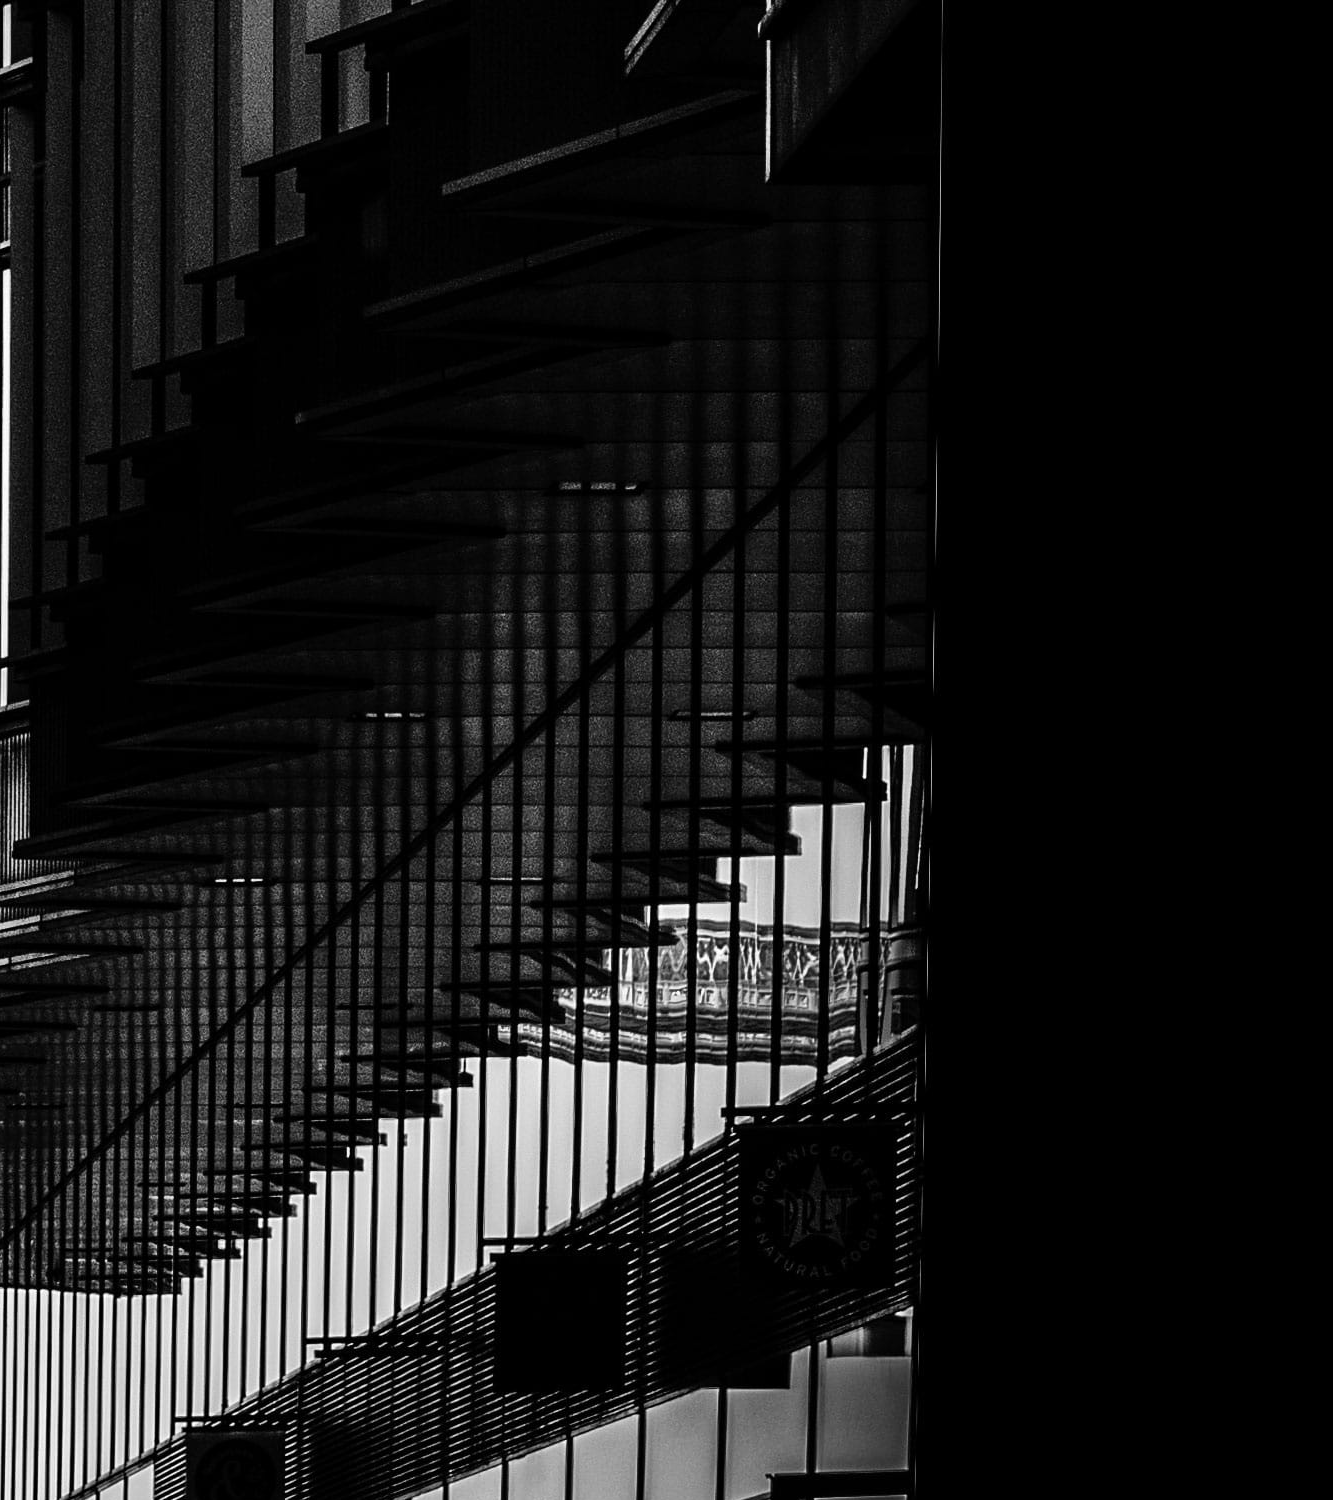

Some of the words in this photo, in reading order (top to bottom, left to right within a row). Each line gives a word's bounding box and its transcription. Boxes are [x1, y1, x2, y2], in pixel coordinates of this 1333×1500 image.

[751, 1143, 821, 1205] ORGANIC
[830, 1143, 885, 1201] COFFEE
[756, 1231, 834, 1279] NATURAL
[840, 1228, 879, 1271] FOOD
